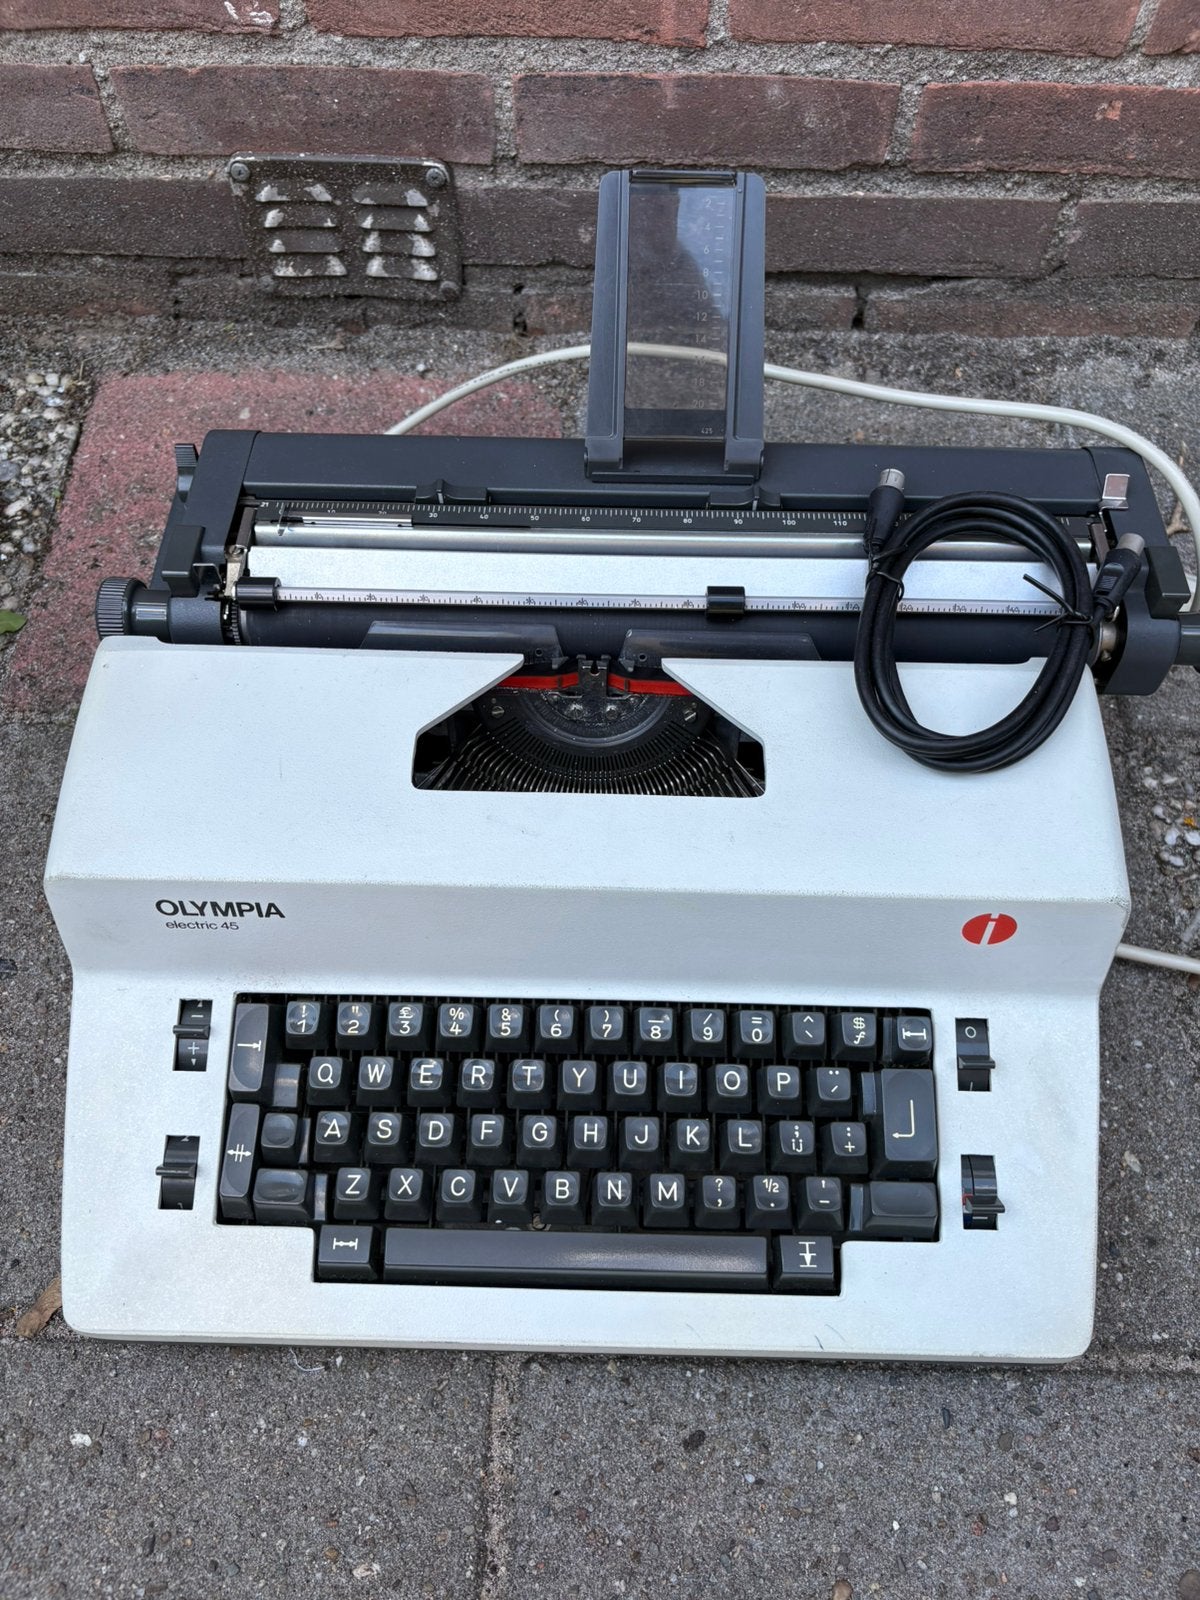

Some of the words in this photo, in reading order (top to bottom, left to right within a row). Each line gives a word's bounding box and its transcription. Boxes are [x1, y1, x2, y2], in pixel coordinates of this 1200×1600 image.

[705, 198, 712, 208] 2
[703, 245, 710, 254] 6
[703, 267, 709, 277] 8
[697, 290, 709, 300] 10
[696, 312, 708, 322] 12
[696, 334, 706, 344] 14
[155, 899, 286, 918] OLYMPIA
[165, 920, 218, 930] electric
[220, 921, 240, 931] 45
[302, 1004, 306, 1018] !
[449, 1007, 464, 1020] %
[501, 1008, 511, 1020] &
[554, 1010, 560, 1022] (
[604, 1010, 609, 1022] )
[704, 1014, 712, 1024] /
[853, 1017, 865, 1029] $
[298, 1020, 306, 1033] 1
[348, 1021, 359, 1033] 2
[399, 1021, 410, 1034] 3
[450, 1022, 462, 1035] 4
[500, 1023, 511, 1036] 5
[550, 1024, 561, 1036] 6
[602, 1024, 612, 1037] 7
[650, 1026, 662, 1039] 8
[703, 1027, 713, 1040] 9
[318, 1064, 334, 1084] Q
[367, 1064, 386, 1083] W
[420, 1064, 434, 1084] E
[471, 1066, 485, 1084] R
[522, 1066, 537, 1085] T
[572, 1068, 588, 1087] Y
[624, 1069, 637, 1088] U
[678, 1070, 683, 1089] I
[724, 1071, 740, 1090] O
[776, 1072, 791, 1092] P
[324, 1119, 341, 1138] A
[376, 1120, 392, 1138] S
[428, 1121, 444, 1140] D
[480, 1120, 496, 1140] F
[532, 1122, 548, 1142] G
[584, 1124, 598, 1142] H
[634, 1126, 648, 1144] J
[686, 1126, 700, 1145] K
[738, 1128, 752, 1146] L
[846, 1126, 850, 1137] :
[844, 1141, 855, 1152] +
[345, 1175, 361, 1194] Z
[397, 1176, 413, 1195] X
[450, 1176, 466, 1196] C
[503, 1178, 519, 1196] V
[556, 1179, 570, 1198] B
[607, 1180, 622, 1200] N
[658, 1182, 677, 1202] M
[715, 1178, 722, 1192] ?
